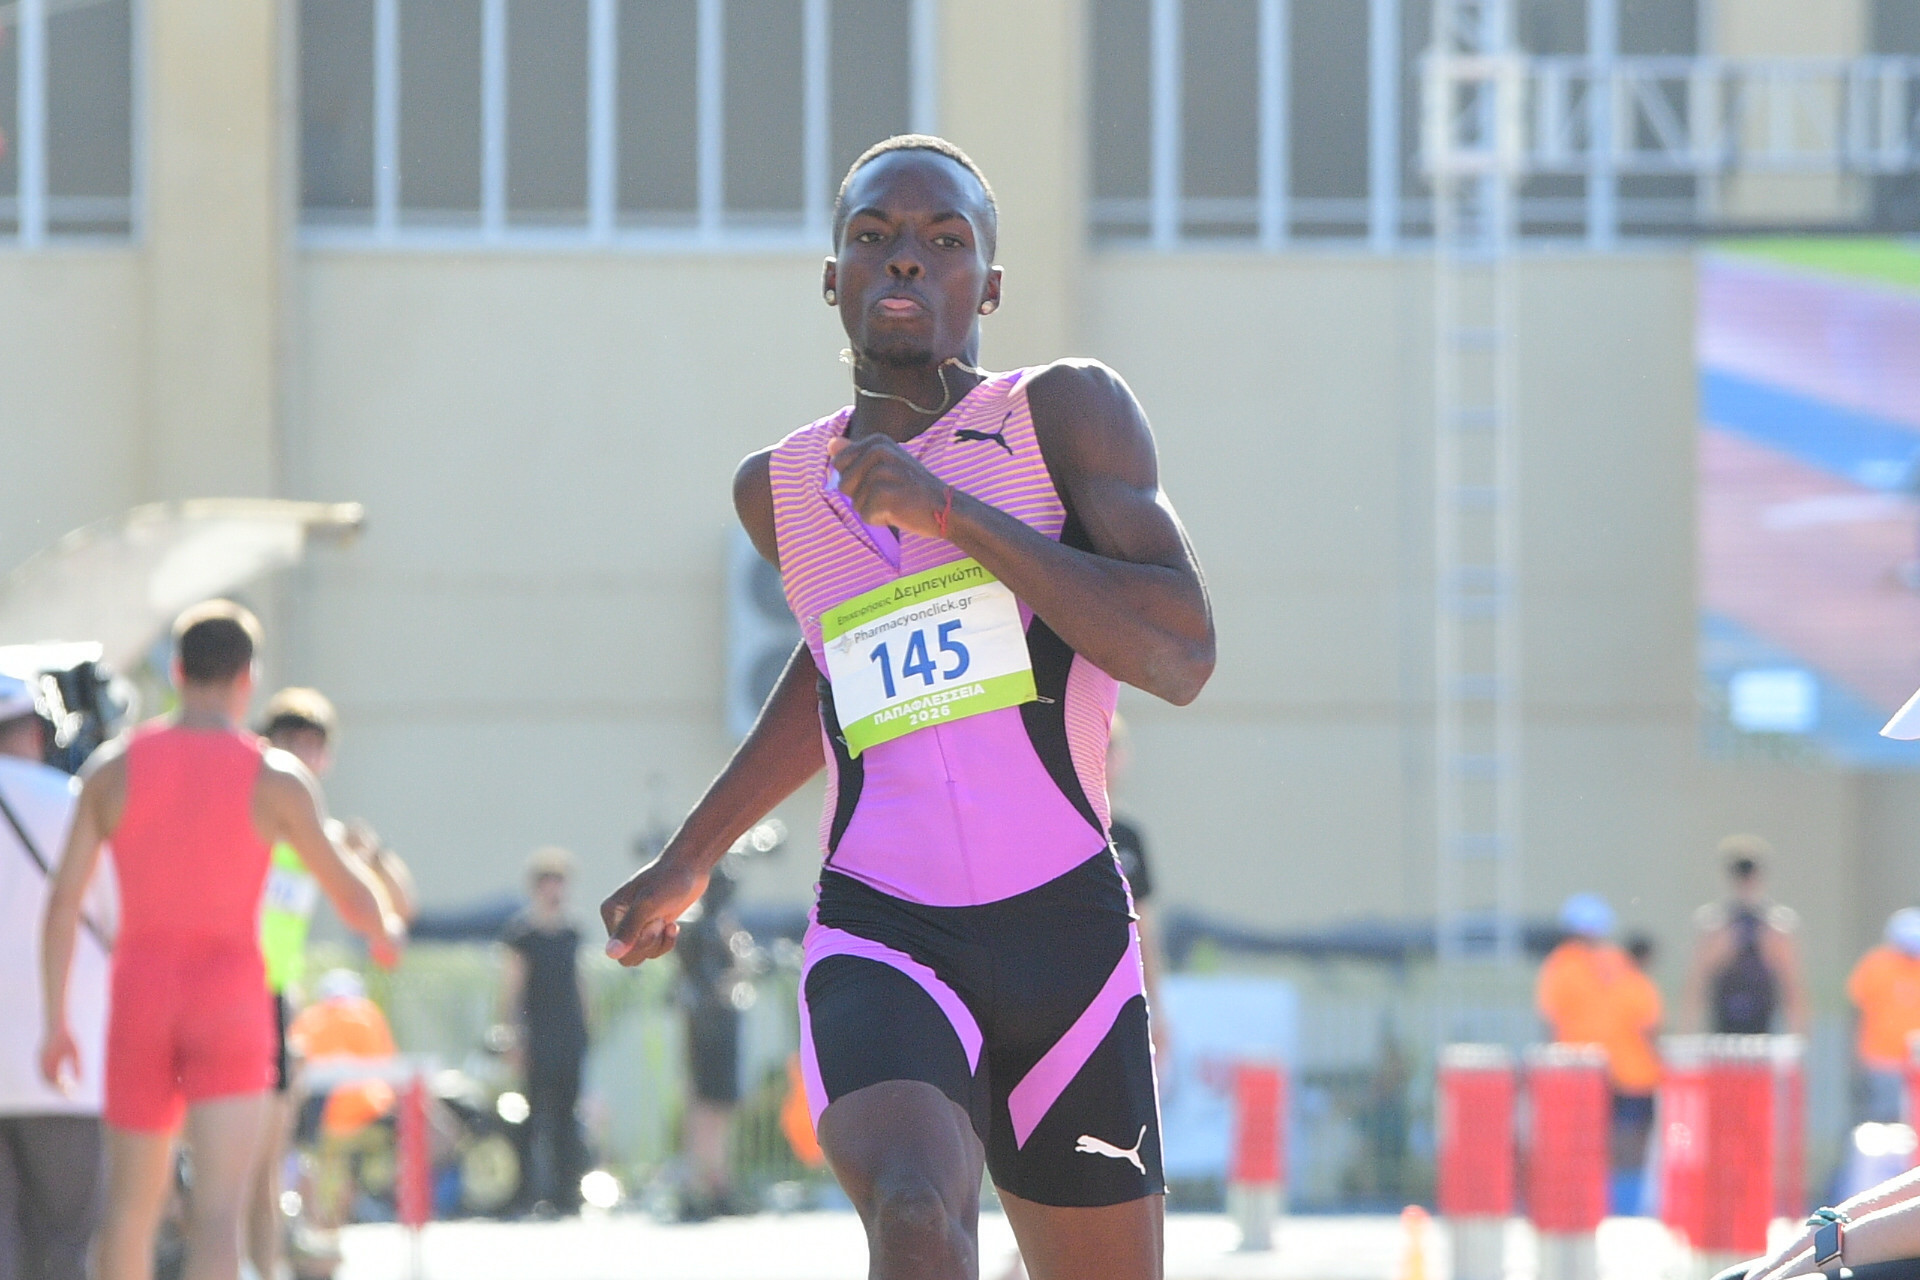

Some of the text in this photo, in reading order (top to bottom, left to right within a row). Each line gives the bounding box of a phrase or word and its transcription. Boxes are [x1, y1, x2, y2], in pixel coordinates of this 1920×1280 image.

[893, 566, 983, 601] Δεμπεγιώτη
[854, 595, 973, 643] Pharmacyonclick.gr
[869, 619, 970, 698] 145
[874, 684, 985, 725] ΠΑΠΑΦΛΕΣΣΕΙΑ
[909, 705, 951, 725] 2026
